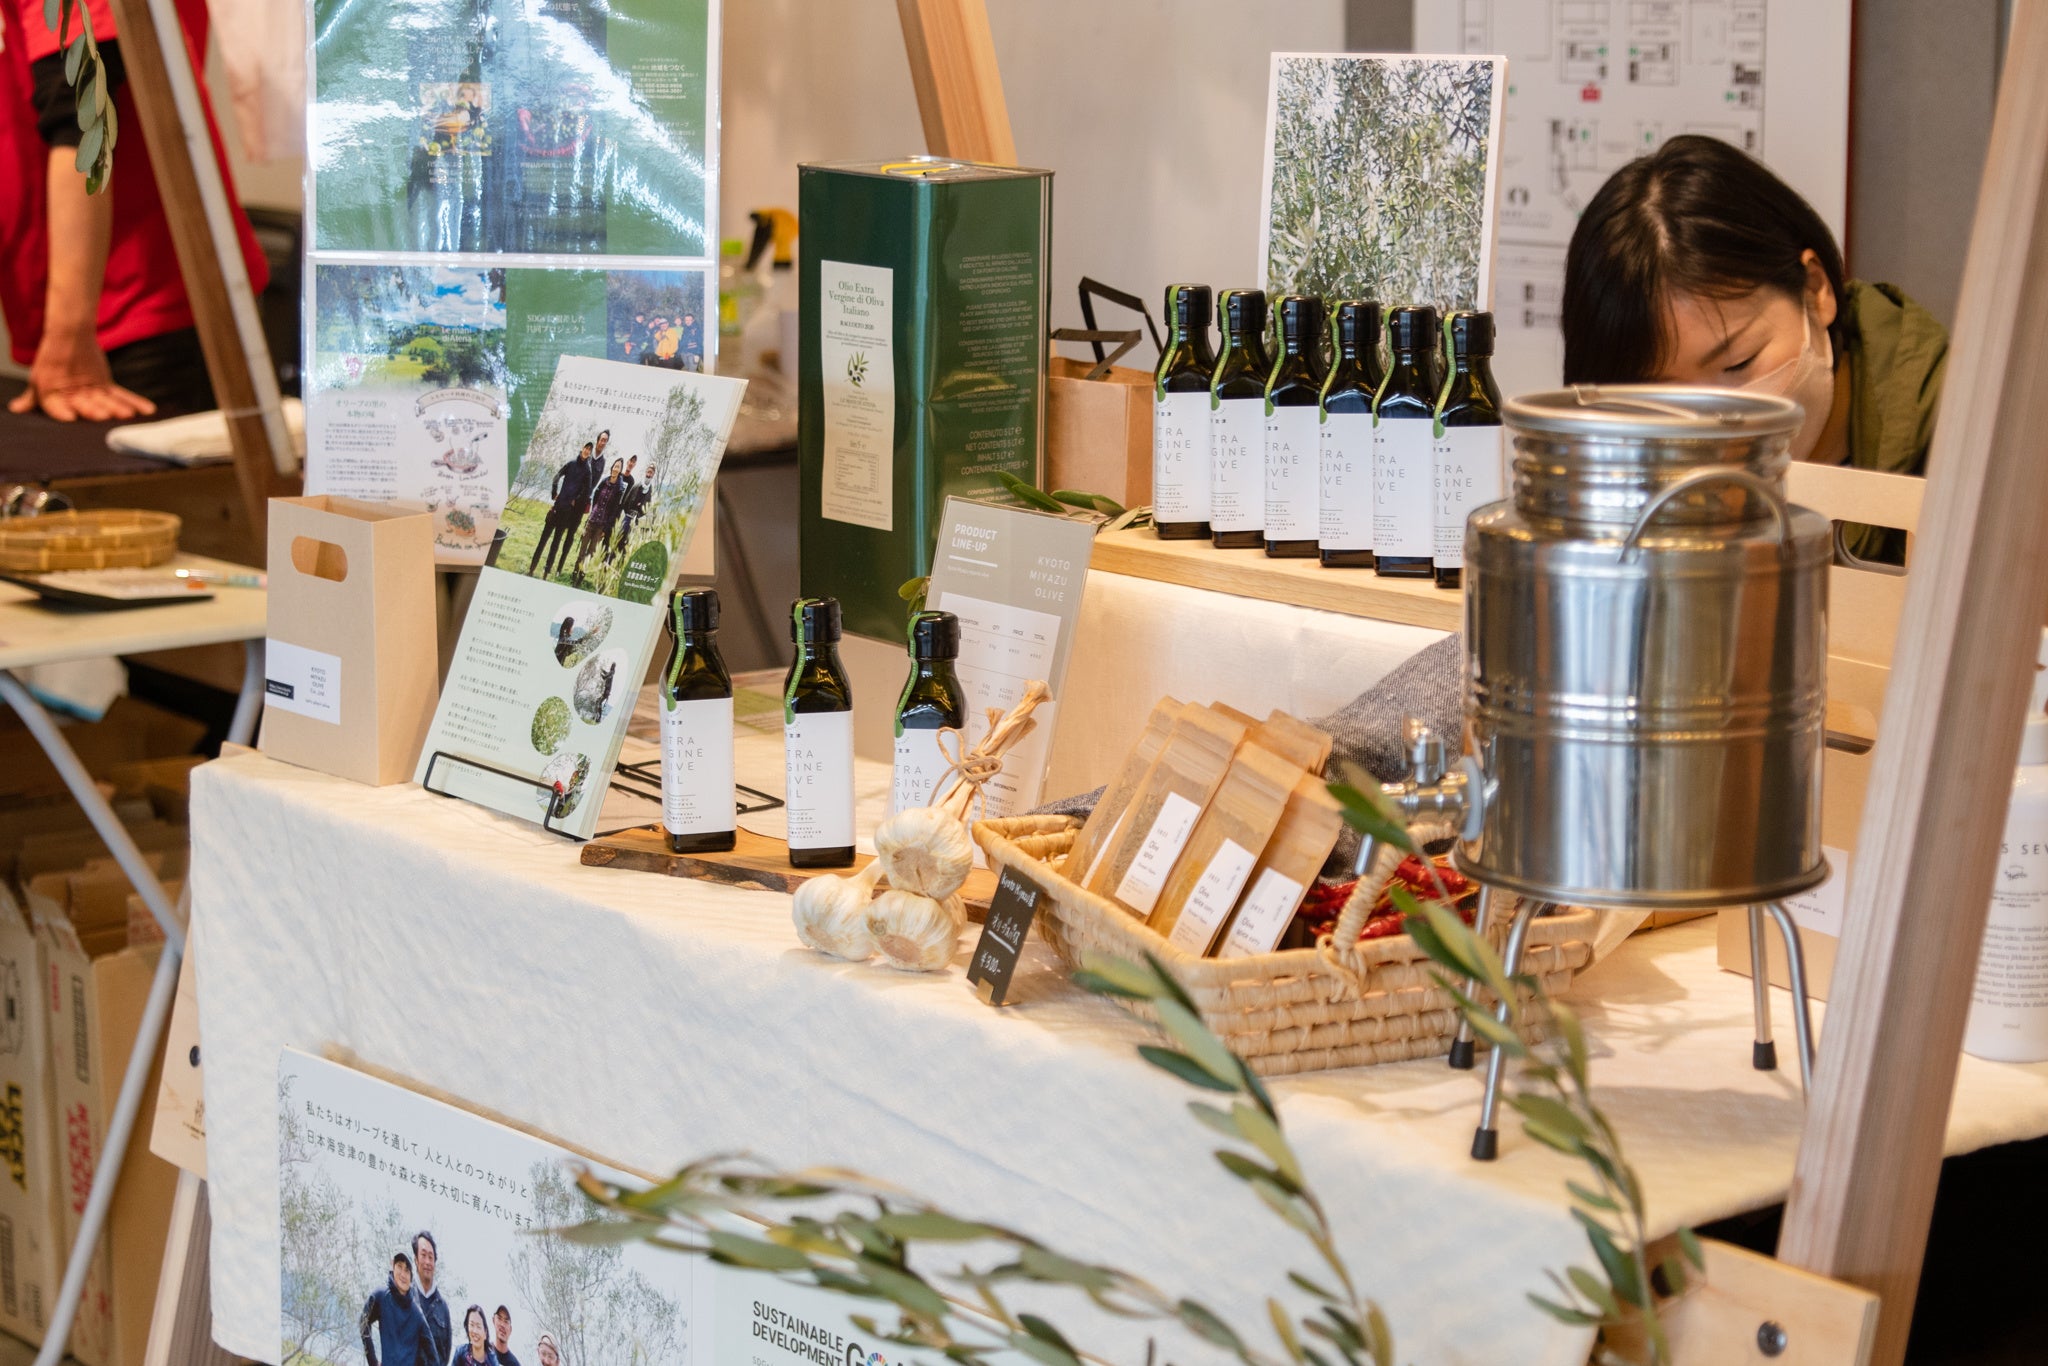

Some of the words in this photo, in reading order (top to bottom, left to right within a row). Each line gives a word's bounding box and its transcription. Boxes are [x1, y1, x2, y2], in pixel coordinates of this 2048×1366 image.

[838, 281, 853, 291] Olio
[855, 283, 874, 294] Extra
[829, 290, 855, 303] Vergine
[856, 295, 864, 304] di
[865, 295, 884, 307] Oliva
[843, 304, 870, 317] Italiano
[969, 428, 1004, 440] CONTENUTO
[965, 442, 977, 452] NET
[954, 523, 998, 541] PRODUCT
[951, 537, 988, 553] LINE-UP
[1037, 555, 1071, 572] KYOTO
[1029, 569, 1068, 587] MIYAZU
[1034, 587, 1065, 602] OLIVE
[1001, 873, 1016, 892] Kyoto
[7, 1082, 27, 1196] LUCKY
[306, 1100, 419, 1157] 私たちはオリーブを通して
[424, 1146, 528, 1199] 人と人とのつながりと
[306, 1129, 534, 1230] 日本海宮津の豊かな森と海を大切に育んでいます
[752, 1300, 844, 1354] SUSTAINABLE
[752, 1320, 844, 1366] DEVELOPMENT
